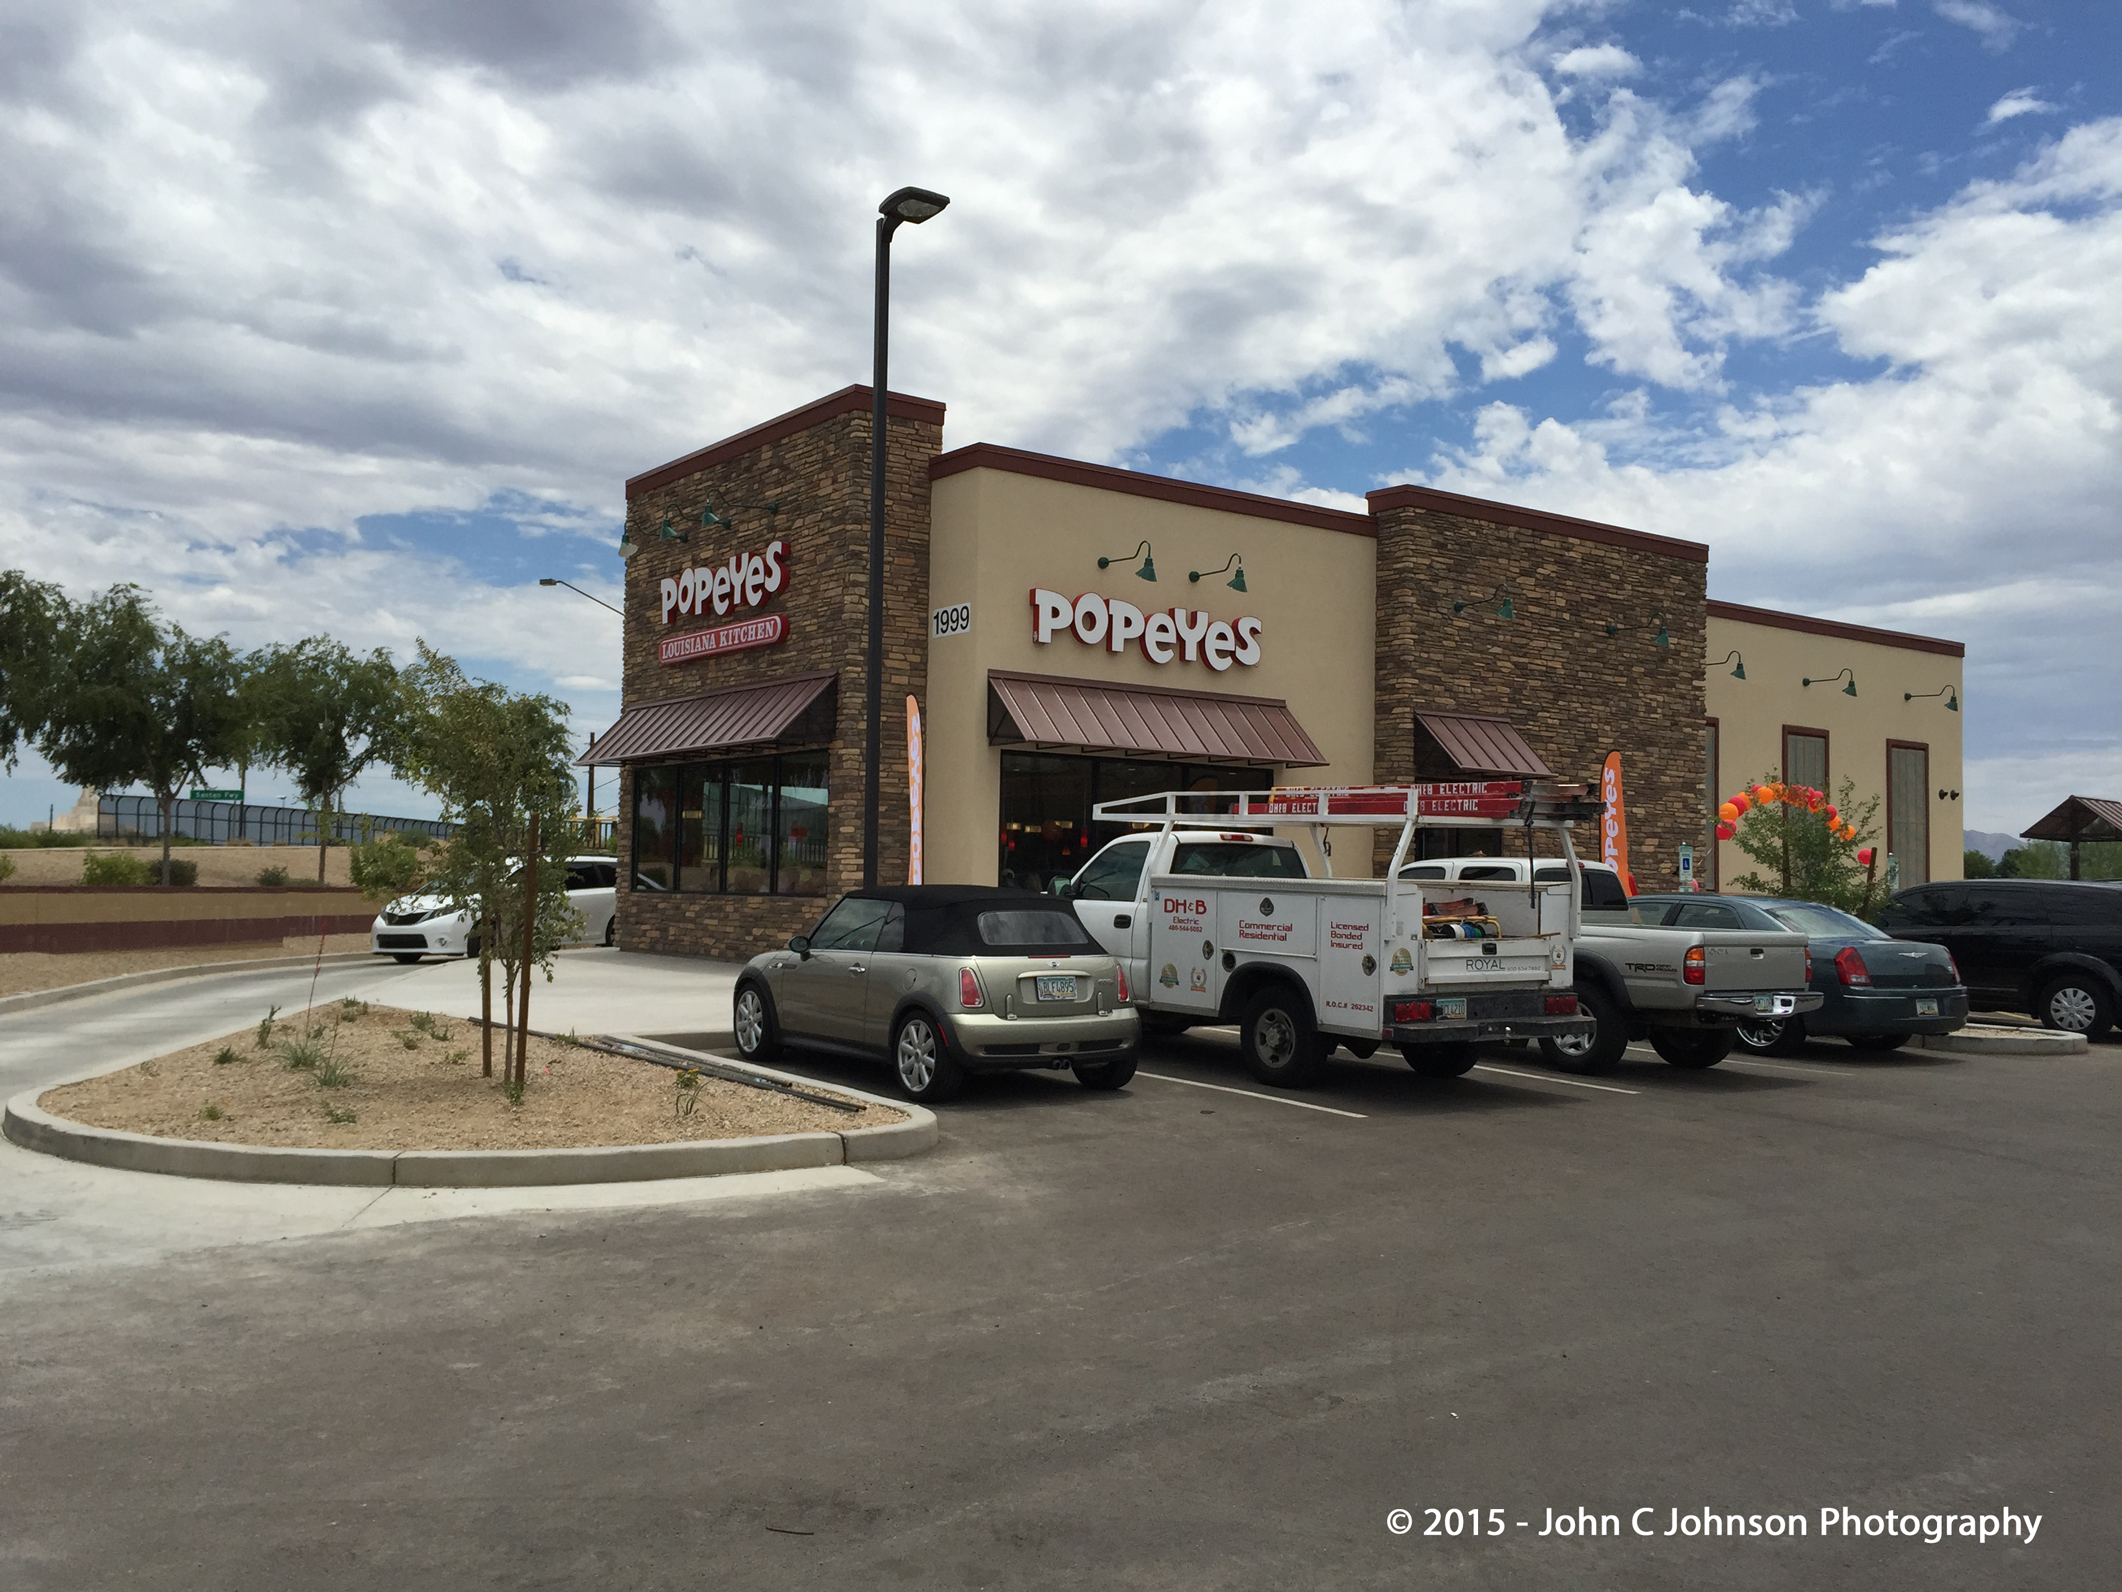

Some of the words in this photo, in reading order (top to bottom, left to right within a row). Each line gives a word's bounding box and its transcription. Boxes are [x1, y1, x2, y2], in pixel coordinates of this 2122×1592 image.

[933, 605, 970, 635] 1999
[662, 633, 717, 660] LOUISIANA
[719, 620, 775, 648] KITCHEN
[1439, 782, 1488, 795] ELECTRIC
[1291, 803, 1318, 813] ELECT
[1431, 799, 1479, 811] ELECTRIC
[1172, 915, 1200, 925] Electric
[1238, 919, 1293, 932] Commercial
[1330, 921, 1369, 932] Licensed
[1238, 929, 1287, 942] Residential
[1330, 930, 1363, 941] Bonded
[1330, 940, 1363, 951] Insured
[1466, 959, 1505, 971] ROYAL
[1625, 962, 1656, 973] TRD
[1350, 1003, 1374, 1013] 262342
